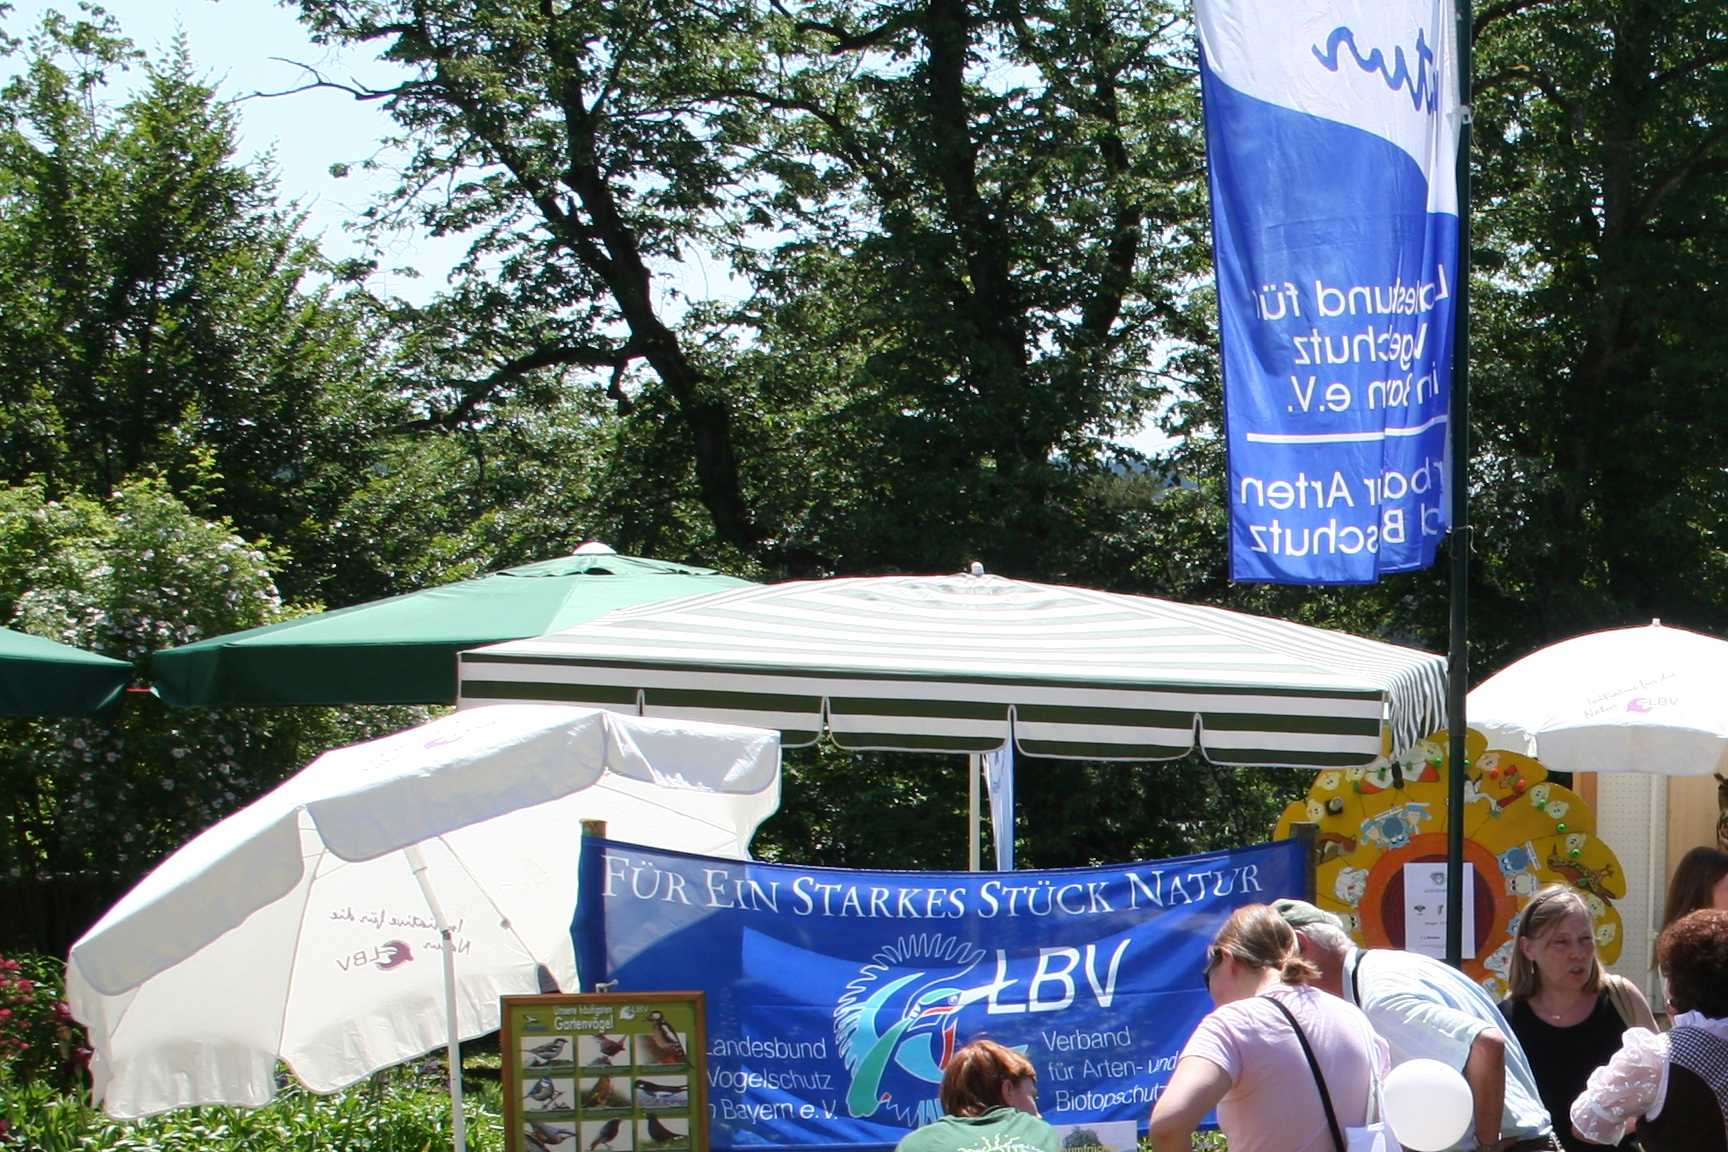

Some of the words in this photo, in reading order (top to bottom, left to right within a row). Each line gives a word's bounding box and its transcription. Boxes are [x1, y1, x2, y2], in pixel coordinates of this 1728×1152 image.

[987, 938, 1132, 1014] LBV
[1042, 1026, 1132, 1052] Verband
[1049, 1062, 1074, 1081] für
[1148, 1050, 1180, 1073] und
[720, 1098, 795, 1124] Bayern
